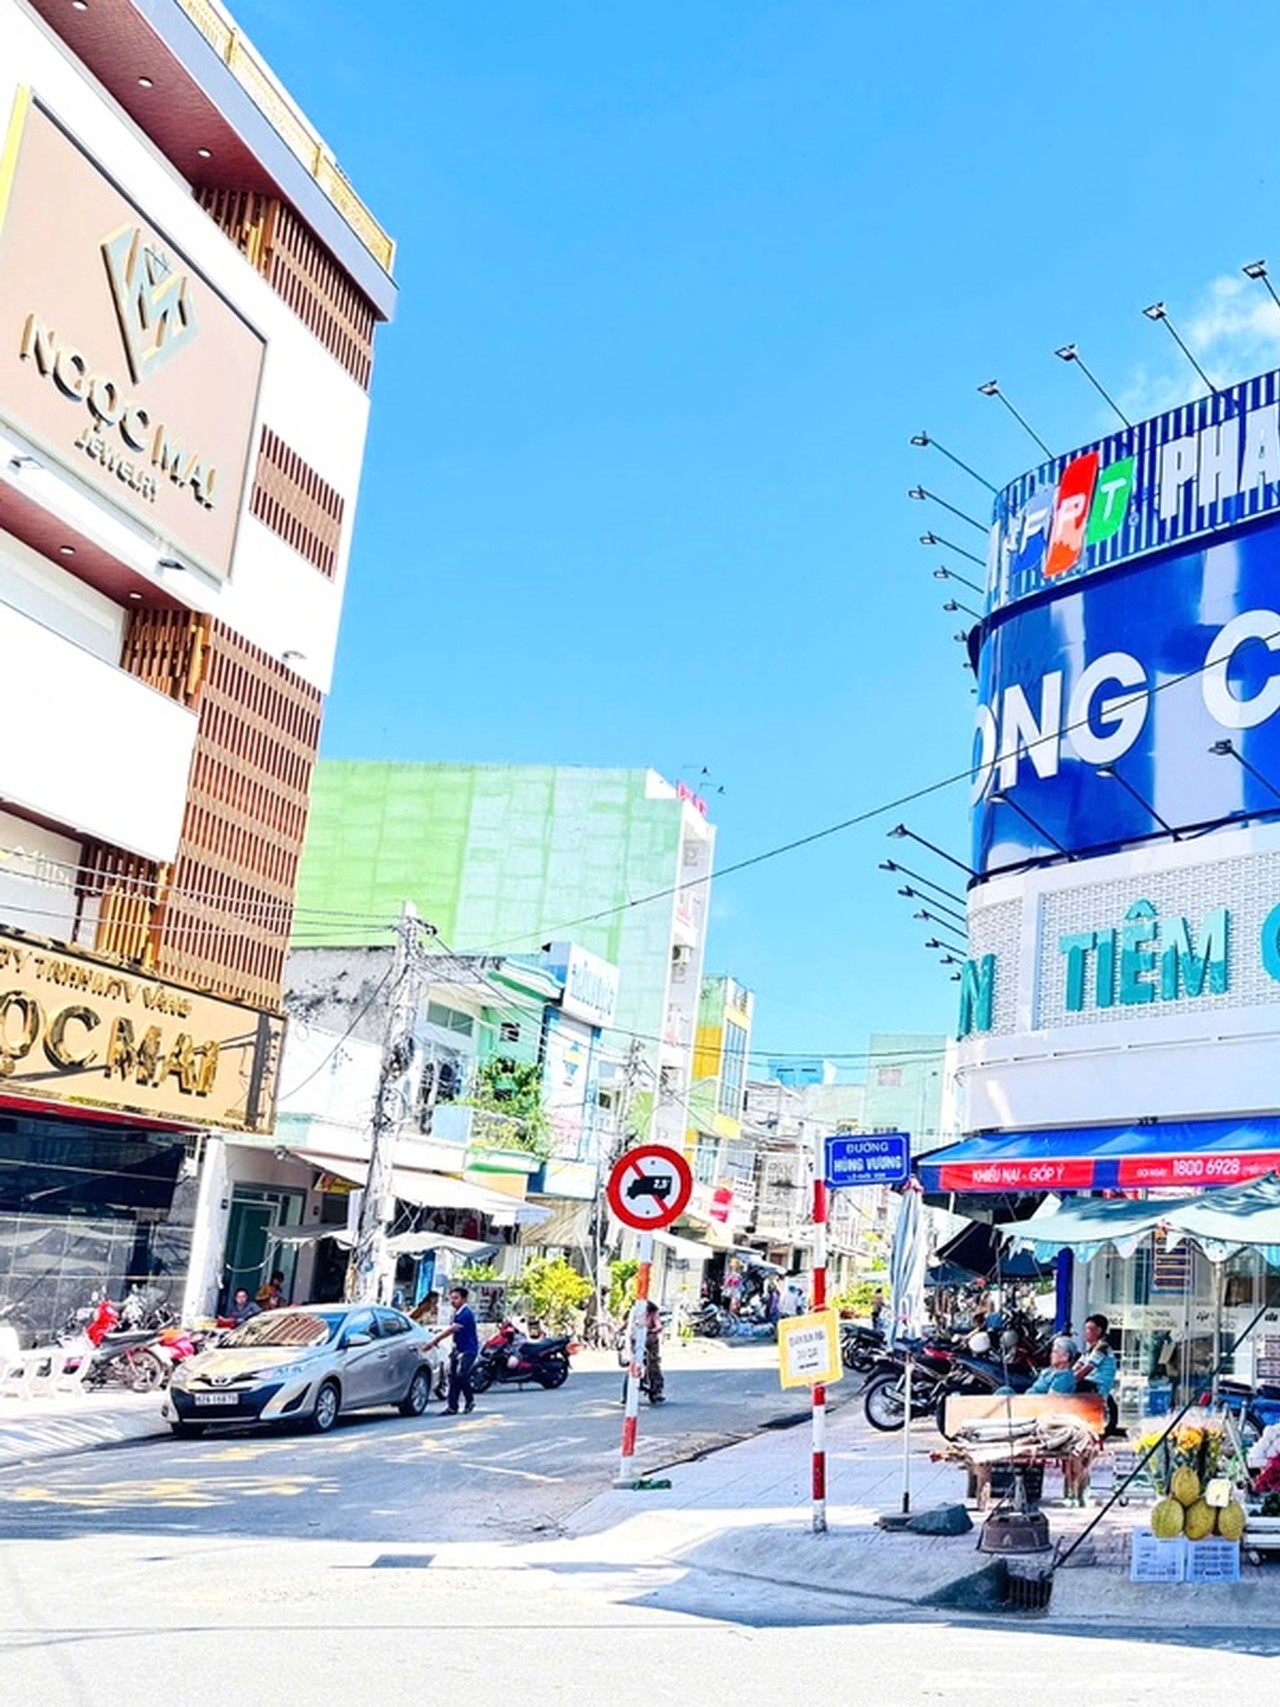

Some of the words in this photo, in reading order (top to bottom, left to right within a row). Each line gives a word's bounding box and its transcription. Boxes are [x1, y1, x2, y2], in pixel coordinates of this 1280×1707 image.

[1058, 898, 1229, 1012] TIÊM
[1002, 1167, 1021, 1186] NẠI
[1028, 1163, 1055, 1182] GÓP
[1172, 1158, 1204, 1177] 1800
[1205, 1157, 1241, 1176] 6928
